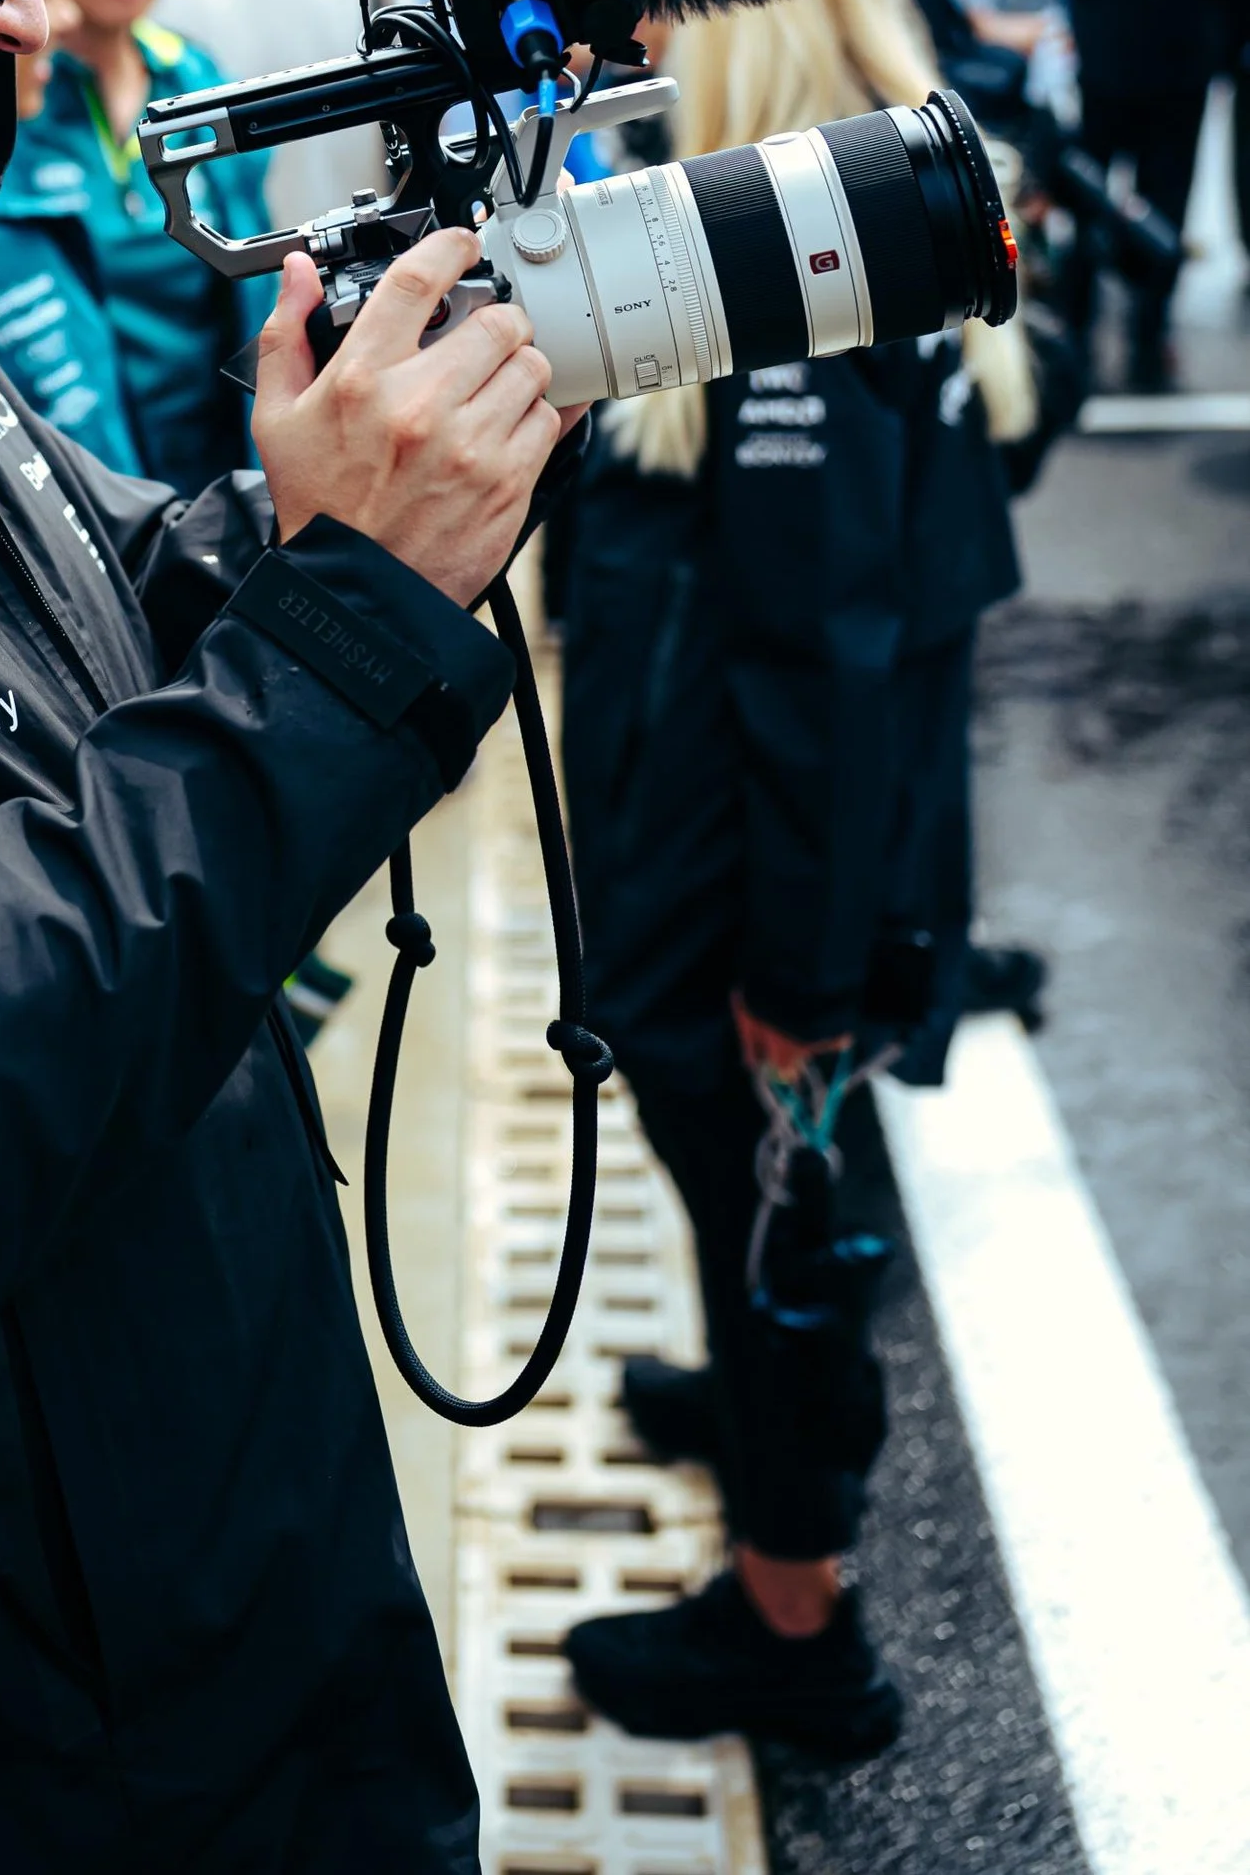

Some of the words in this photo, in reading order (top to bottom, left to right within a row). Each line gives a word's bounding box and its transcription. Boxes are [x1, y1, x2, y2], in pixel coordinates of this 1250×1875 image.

[815, 254, 834, 270] G
[614, 300, 651, 314] SONY
[634, 354, 655, 363] CLICK
